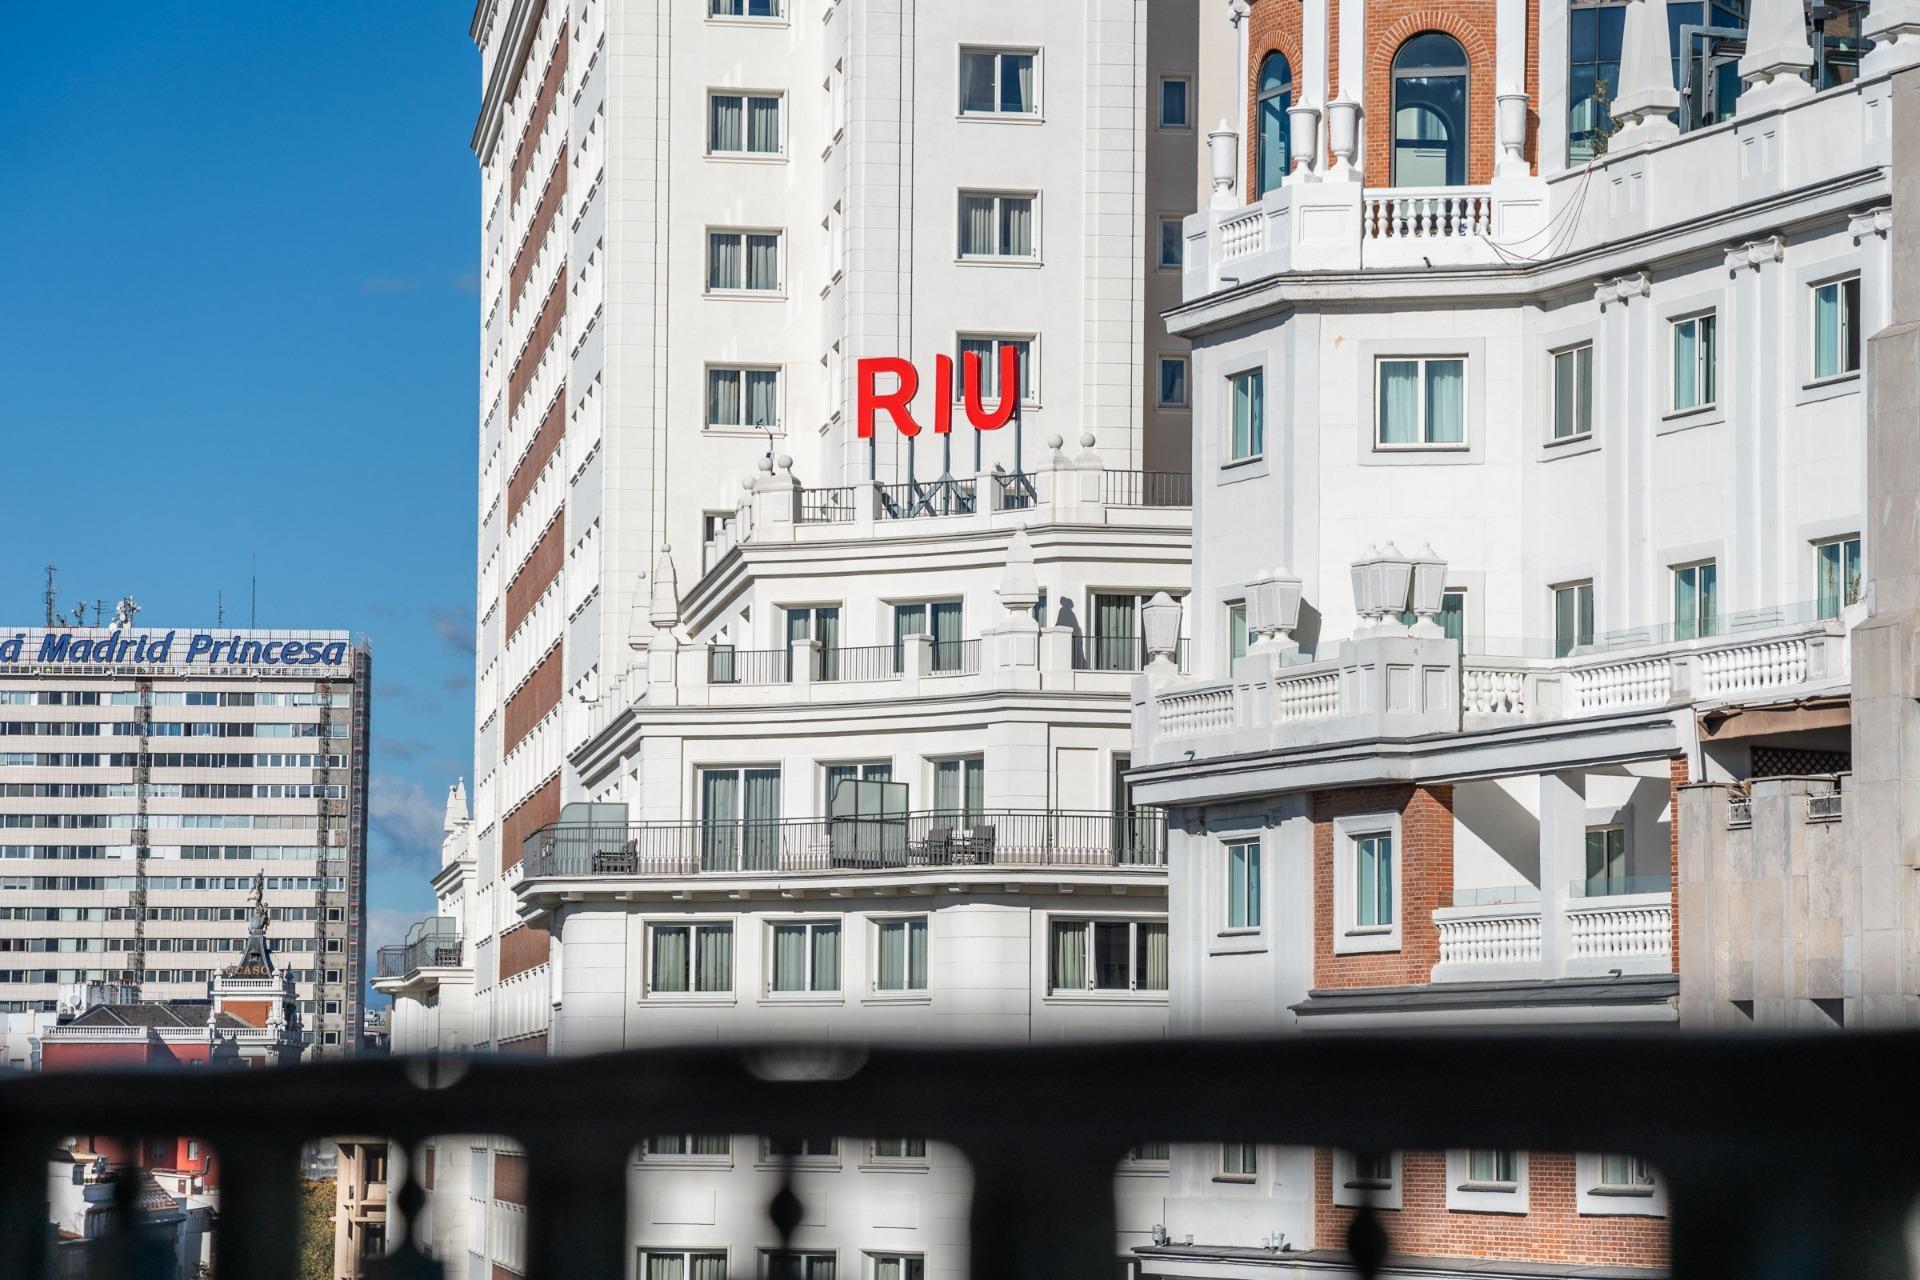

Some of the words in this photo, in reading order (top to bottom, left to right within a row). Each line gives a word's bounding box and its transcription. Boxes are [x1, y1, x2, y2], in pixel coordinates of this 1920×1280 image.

[858, 345, 1018, 438] RIU
[37, 630, 176, 663] Madrid
[186, 634, 347, 666] Princesa
